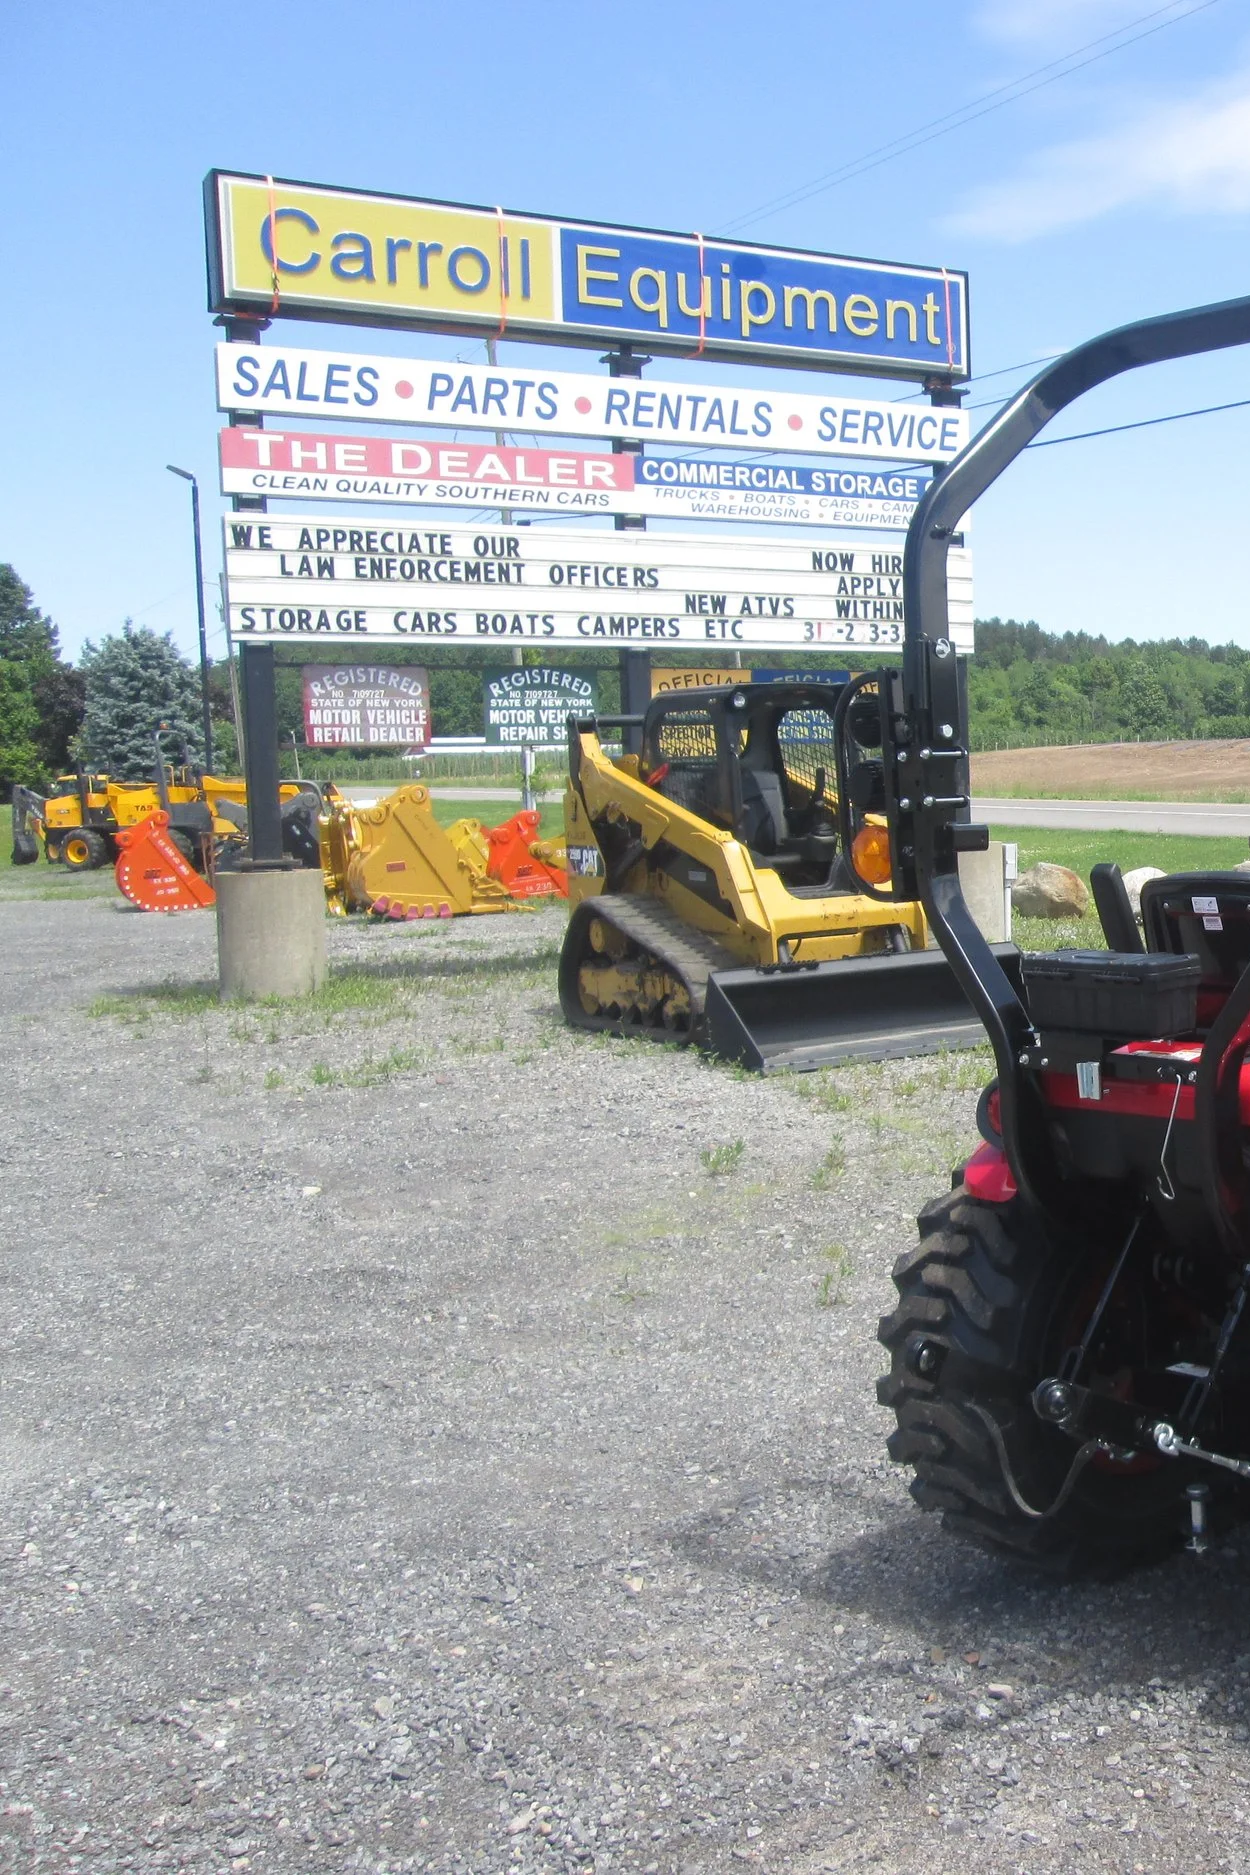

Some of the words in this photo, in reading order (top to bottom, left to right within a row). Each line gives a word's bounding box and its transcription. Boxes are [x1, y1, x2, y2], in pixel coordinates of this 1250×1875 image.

[260, 206, 531, 301] Carroll
[576, 243, 941, 345] Equipment
[232, 355, 380, 407] SALES
[427, 372, 559, 421] PARTS
[604, 387, 773, 438] RENTALS
[816, 405, 960, 453] SERVICE
[243, 432, 368, 473] THE
[391, 442, 617, 487] DEALER
[252, 473, 328, 492] CLEAN
[336, 479, 428, 498] QUALITY
[435, 485, 549, 504] SOUTHERN
[556, 491, 610, 507] CARS
[641, 459, 805, 491] COMMERCIAL
[811, 471, 918, 499] STORAGE
[653, 487, 720, 501] TRUCKS
[744, 493, 796, 506] BOATS
[818, 498, 860, 510] CARS
[691, 503, 811, 519] WAREHOUSING
[832, 511, 912, 525] EQUIPMEN
[231, 525, 273, 549] WE
[299, 528, 453, 556] APPRECIATE
[473, 535, 521, 558] OUR
[280, 554, 335, 578] LAW
[354, 557, 526, 584] ENFORCEMENT
[549, 565, 659, 589] OFFICERS
[811, 551, 855, 573] NOW
[872, 554, 903, 574] HIR
[837, 575, 901, 596] APPLY
[685, 594, 728, 616] NEW
[739, 596, 795, 617] ATVS
[835, 599, 903, 620] WITHIN
[240, 607, 368, 632] STORAGE
[393, 611, 457, 634] CARS
[475, 613, 555, 636] BOATS
[577, 615, 680, 638] CAMPERS
[704, 618, 743, 639] ETC
[308, 667, 423, 697] REGISTERED
[488, 668, 592, 698] REGISTERED
[658, 673, 741, 691] OFFICIA
[311, 699, 344, 707] STATE
[349, 699, 363, 707] OF
[366, 699, 390, 708] NEW
[393, 699, 423, 708] YORK
[490, 699, 521, 707] STATE
[524, 699, 538, 707] OF
[541, 699, 564, 707] NEW
[566, 699, 593, 707] YORK
[309, 709, 361, 725] MOTOR
[367, 709, 427, 725] VEHICLE
[489, 709, 536, 725] MOTOR
[313, 726, 365, 744] RETAIL
[369, 726, 425, 743] DEALER
[499, 726, 550, 742] REPAIR
[553, 726, 569, 742] SH
[582, 849, 598, 876] CAT
